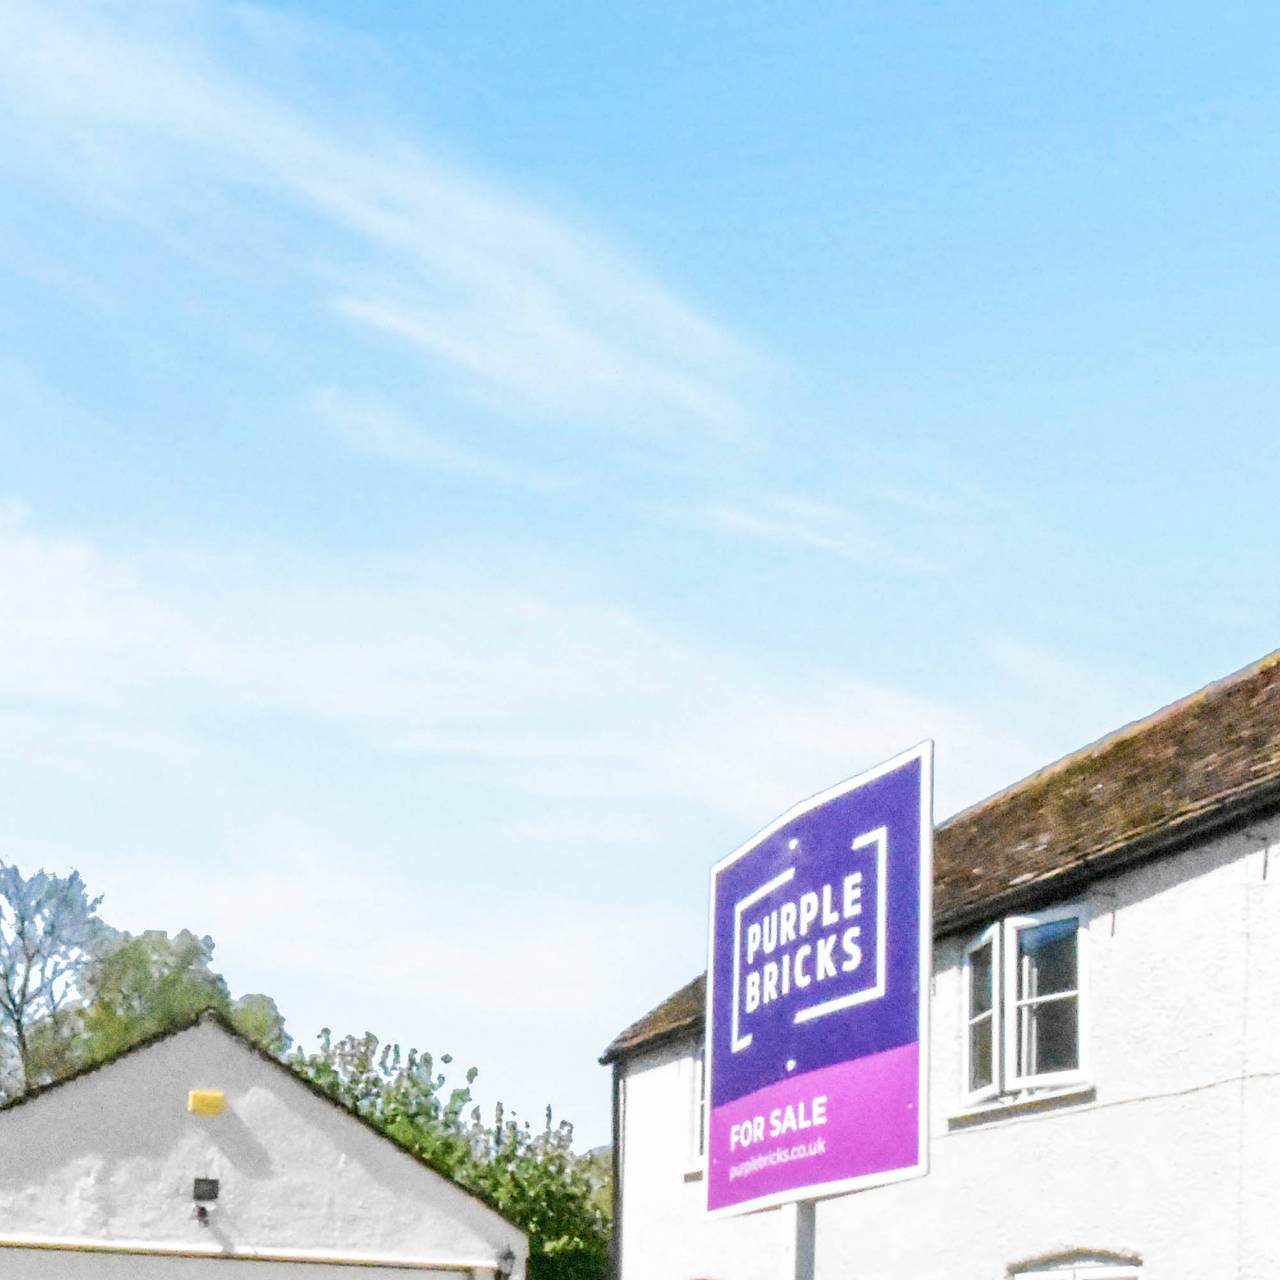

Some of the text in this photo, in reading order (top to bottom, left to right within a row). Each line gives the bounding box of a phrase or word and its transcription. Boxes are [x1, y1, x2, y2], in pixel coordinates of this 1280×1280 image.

[747, 872, 862, 964] PURPLE
[746, 926, 862, 1014] BRICKS
[730, 1095, 828, 1151] FOR SALE
